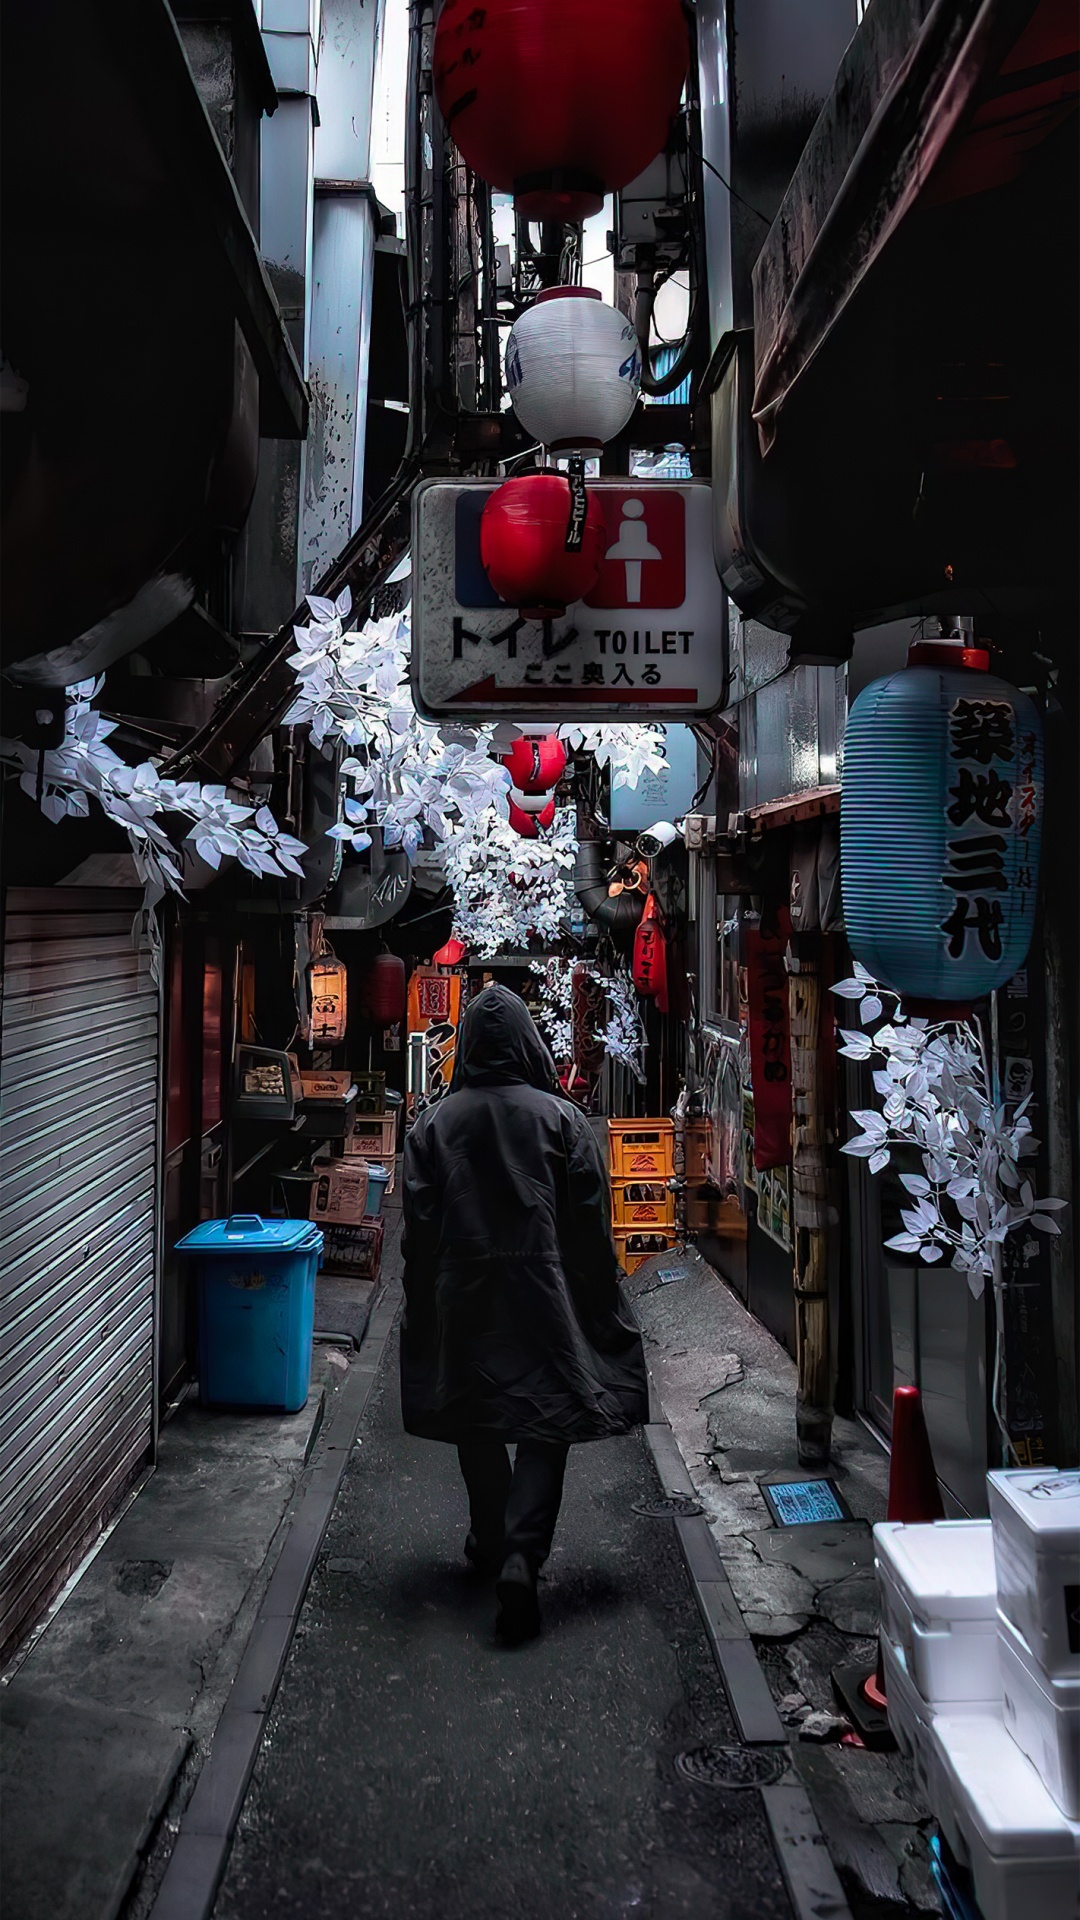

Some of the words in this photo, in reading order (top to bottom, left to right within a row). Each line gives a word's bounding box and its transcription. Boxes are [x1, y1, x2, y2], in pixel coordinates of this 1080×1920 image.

[452, 616, 579, 659] トイレ
[594, 630, 695, 655] TOILET
[523, 662, 662, 687] ここ奥入る
[941, 698, 1014, 961] 築地三代
